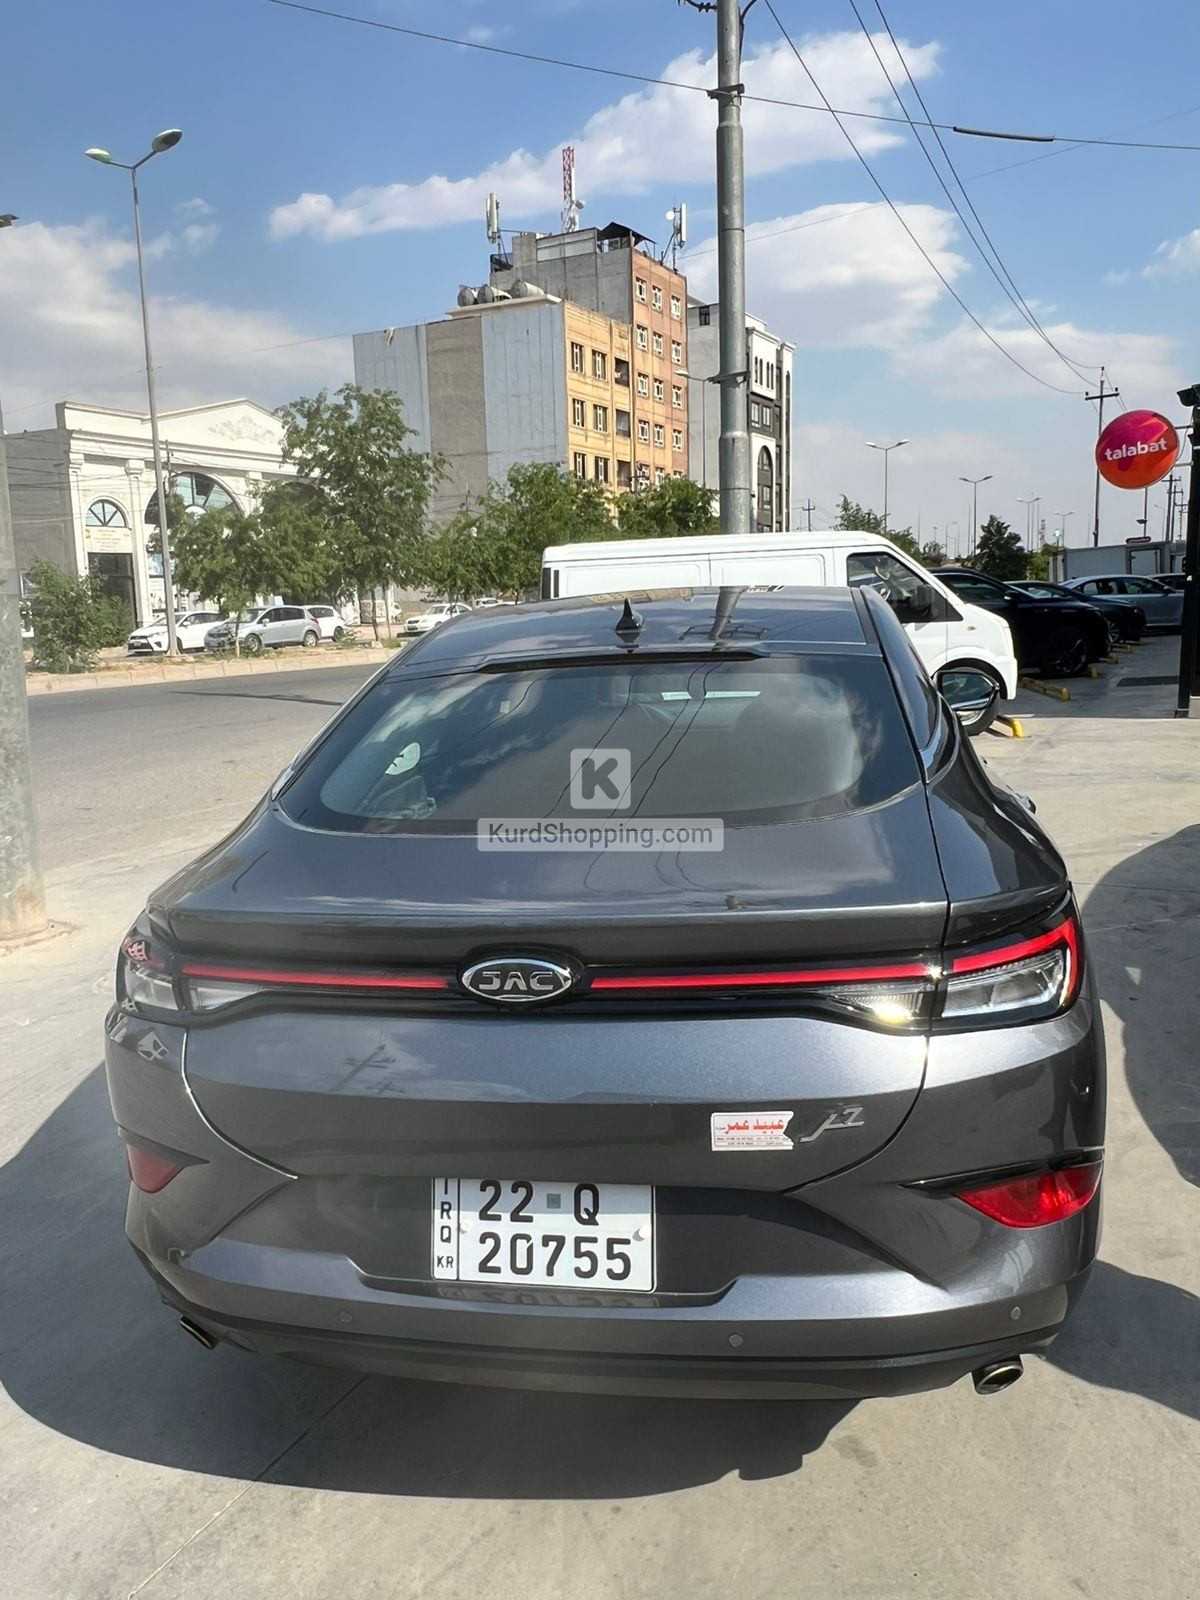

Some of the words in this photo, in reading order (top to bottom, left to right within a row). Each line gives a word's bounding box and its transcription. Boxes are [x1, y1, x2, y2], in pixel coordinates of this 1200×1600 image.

[1104, 437, 1168, 461] talabat
[478, 971, 554, 991] JAC
[478, 1179, 534, 1223] 22
[573, 1183, 600, 1226] Q
[436, 1256, 454, 1269] KR
[478, 1231, 632, 1281] 20755
